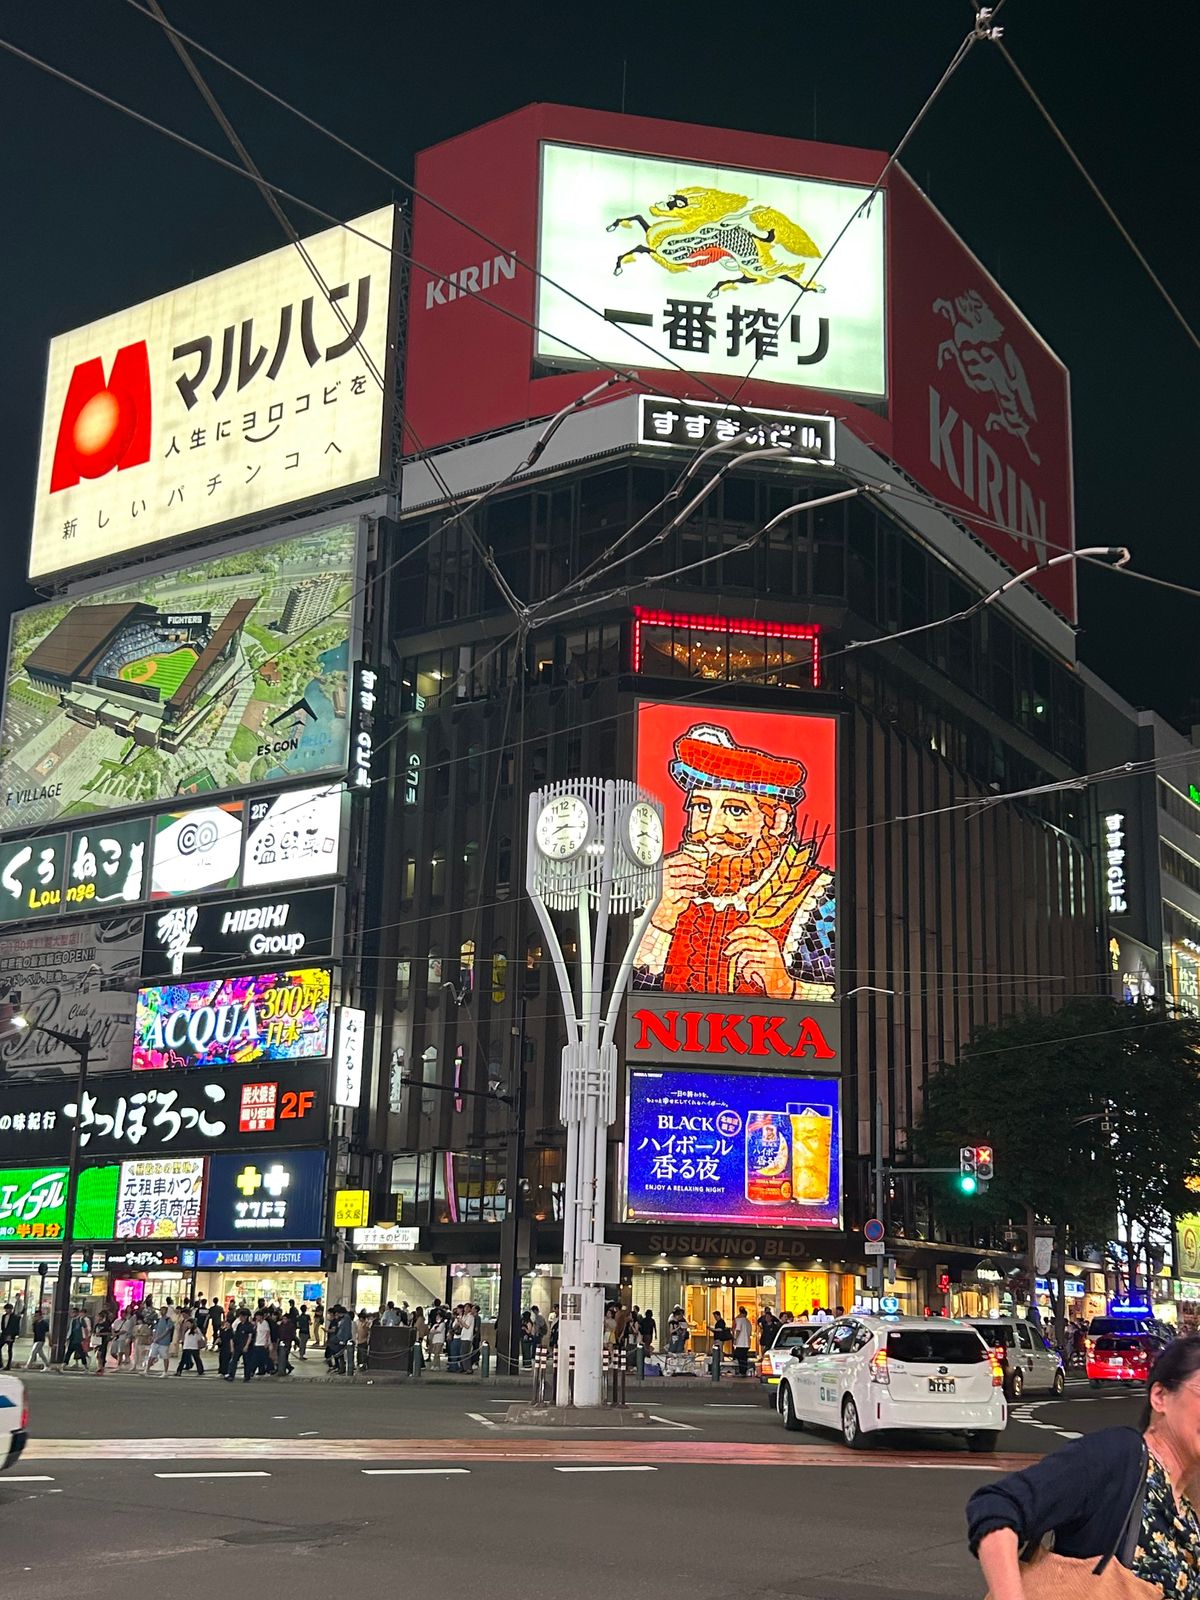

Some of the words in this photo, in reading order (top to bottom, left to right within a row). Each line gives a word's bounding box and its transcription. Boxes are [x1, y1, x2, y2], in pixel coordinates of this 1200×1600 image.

[425, 250, 517, 310] KIRIN
[172, 275, 371, 411] マルハン
[604, 298, 830, 365] 一番搾り
[165, 375, 366, 458] 人生にヨロコビを
[929, 385, 1047, 567] KIRIN
[62, 441, 342, 540] 新しいパチンコへ
[167, 615, 203, 624] FIGHTERS
[257, 743, 271, 756] ES
[6, 792, 14, 806] F
[16, 782, 63, 804] VILLAGE
[252, 804, 268, 819] 2F
[28, 883, 95, 908] Lounge
[221, 903, 290, 934] HIBIKI
[250, 933, 305, 956] Group
[260, 985, 322, 1019] 300坪
[142, 1003, 259, 1052] ACQUA
[632, 1009, 836, 1059] NIKKA
[280, 1091, 315, 1119] 2F
[0, 1110, 57, 1131] の味紀行
[657, 1114, 715, 1132] BLACK
[637, 1134, 734, 1156] ハイボール
[650, 1153, 721, 1181] 香る夜
[124, 1177, 192, 1197] 元祖串かつ
[645, 1183, 666, 1191] ENJOY
[121, 1197, 199, 1218] 恵美須商店
[225, 1252, 252, 1263] HOKKAIDO
[253, 1252, 271, 1263] HAPPY
[272, 1252, 301, 1262] LIFESTYLE
[648, 1234, 756, 1256] SUSUKINO
[764, 1239, 811, 1257] BLD.
